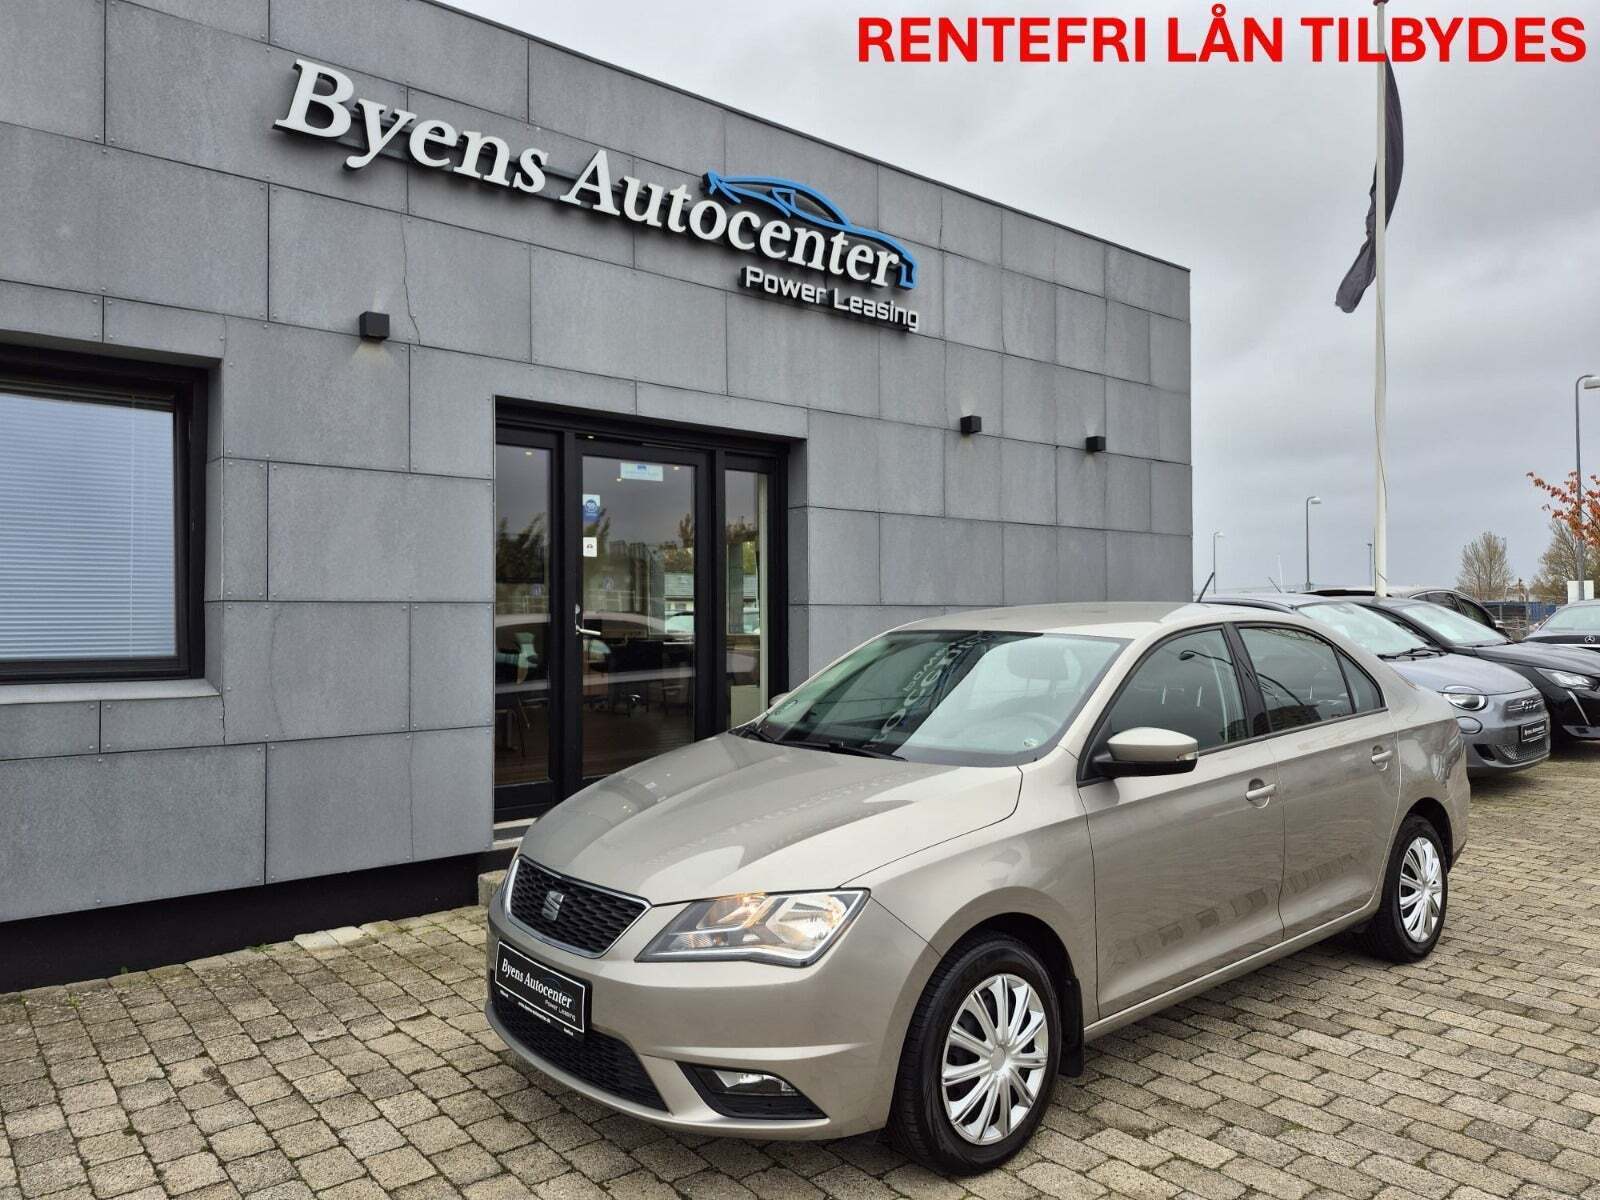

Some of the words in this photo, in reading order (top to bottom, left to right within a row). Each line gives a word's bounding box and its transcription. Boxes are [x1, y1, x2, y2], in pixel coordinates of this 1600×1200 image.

[275, 58, 549, 194] Byens
[560, 150, 901, 287] Autocenter
[745, 265, 827, 304] Power
[833, 287, 920, 333] Leasing
[501, 958, 525, 983] Byens
[523, 972, 573, 1009] Autocenter
